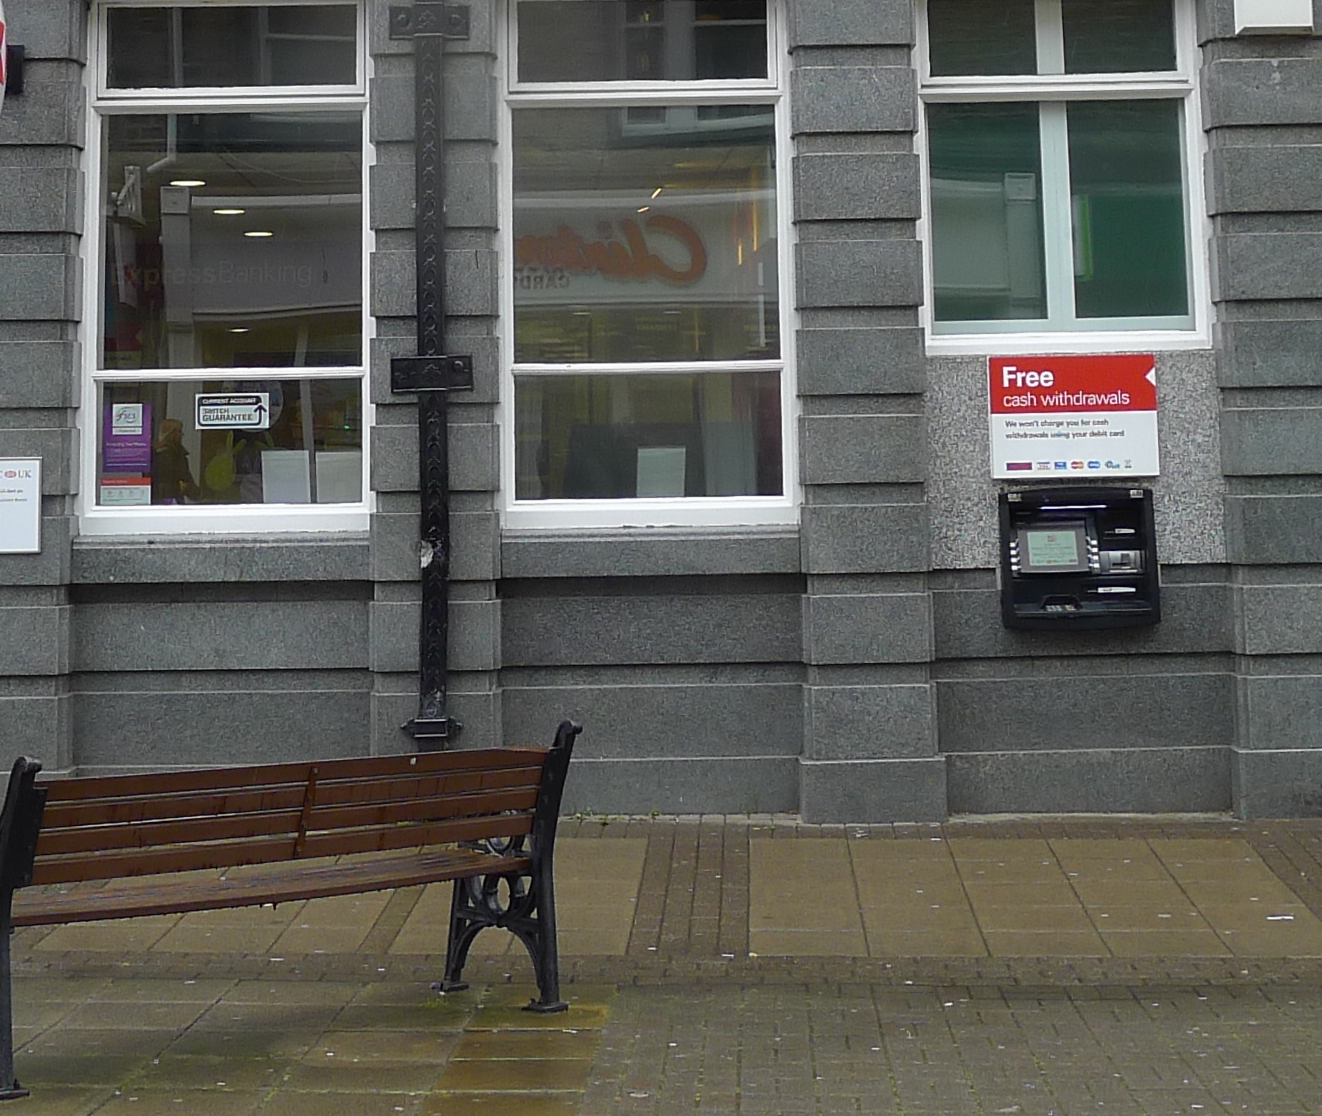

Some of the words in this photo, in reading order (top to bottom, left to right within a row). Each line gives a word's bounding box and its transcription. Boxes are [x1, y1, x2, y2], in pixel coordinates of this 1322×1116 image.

[1002, 366, 1054, 388] Free
[1003, 392, 1037, 407] cash
[1041, 390, 1130, 406] withdrawals
[202, 414, 253, 422] GUARANTEE
[1092, 418, 1109, 426] cash
[1005, 431, 1048, 439] withdrawals
[1051, 431, 1070, 439] using
[1109, 429, 1125, 437] card
[18, 470, 32, 478] UK
